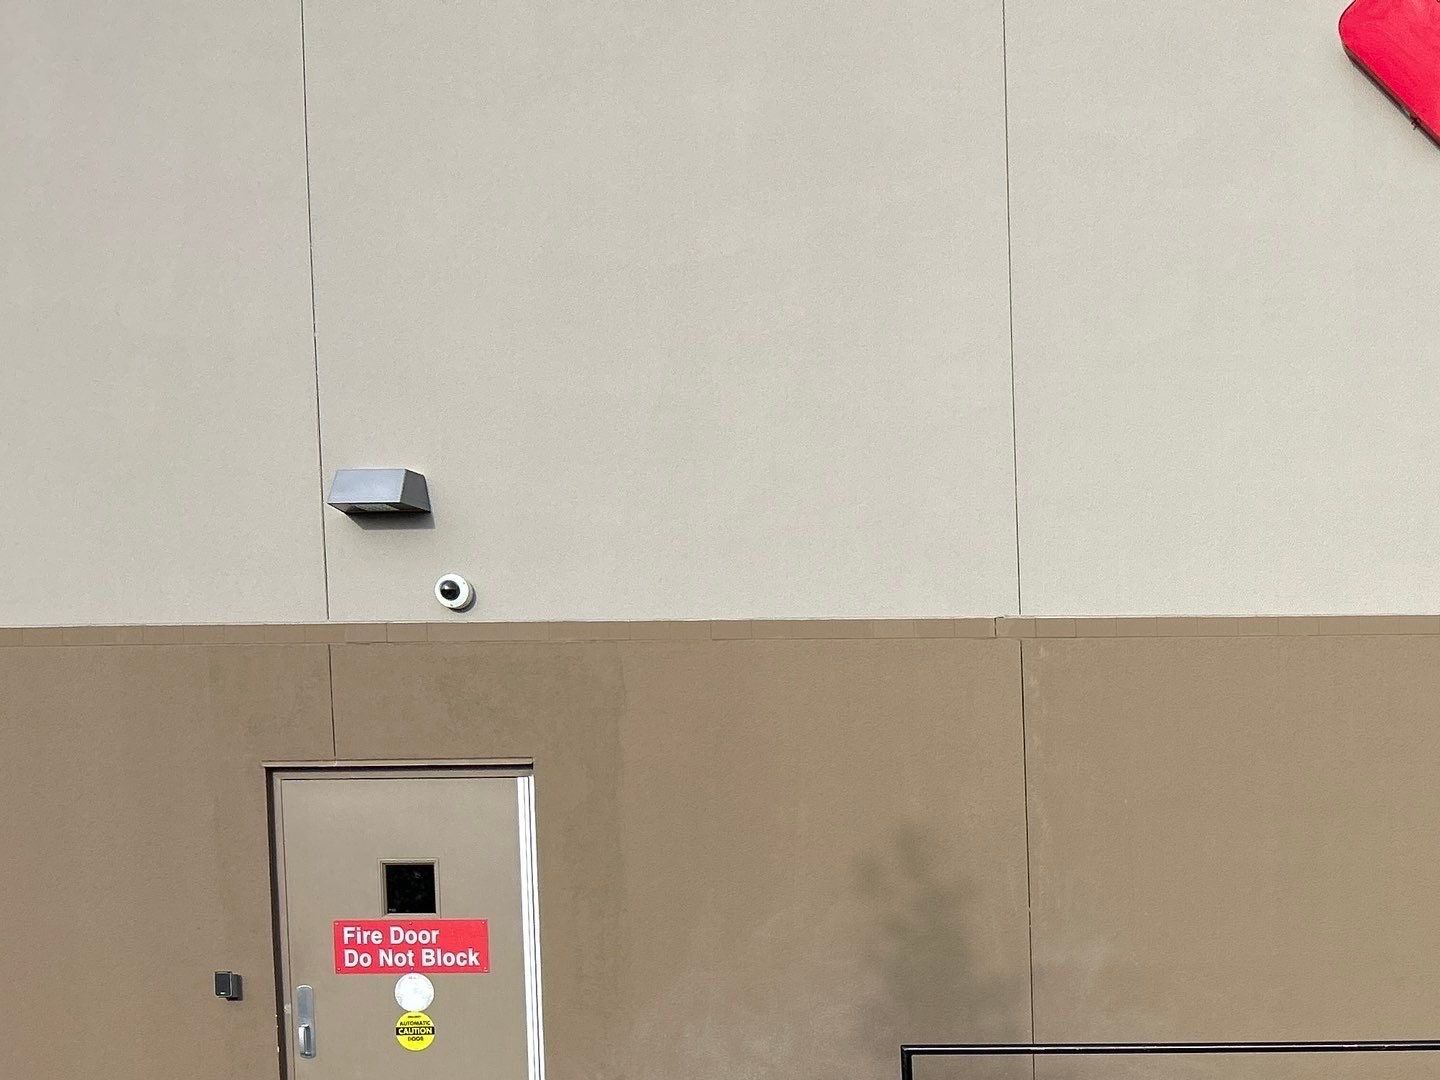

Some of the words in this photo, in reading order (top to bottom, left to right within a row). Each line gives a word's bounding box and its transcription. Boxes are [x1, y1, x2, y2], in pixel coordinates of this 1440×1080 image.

[342, 926, 383, 945] Fire
[389, 926, 440, 945] Door
[344, 949, 372, 967] Do
[378, 949, 415, 967] Not
[421, 948, 481, 967] Block
[398, 1027, 433, 1035] CAUTION
